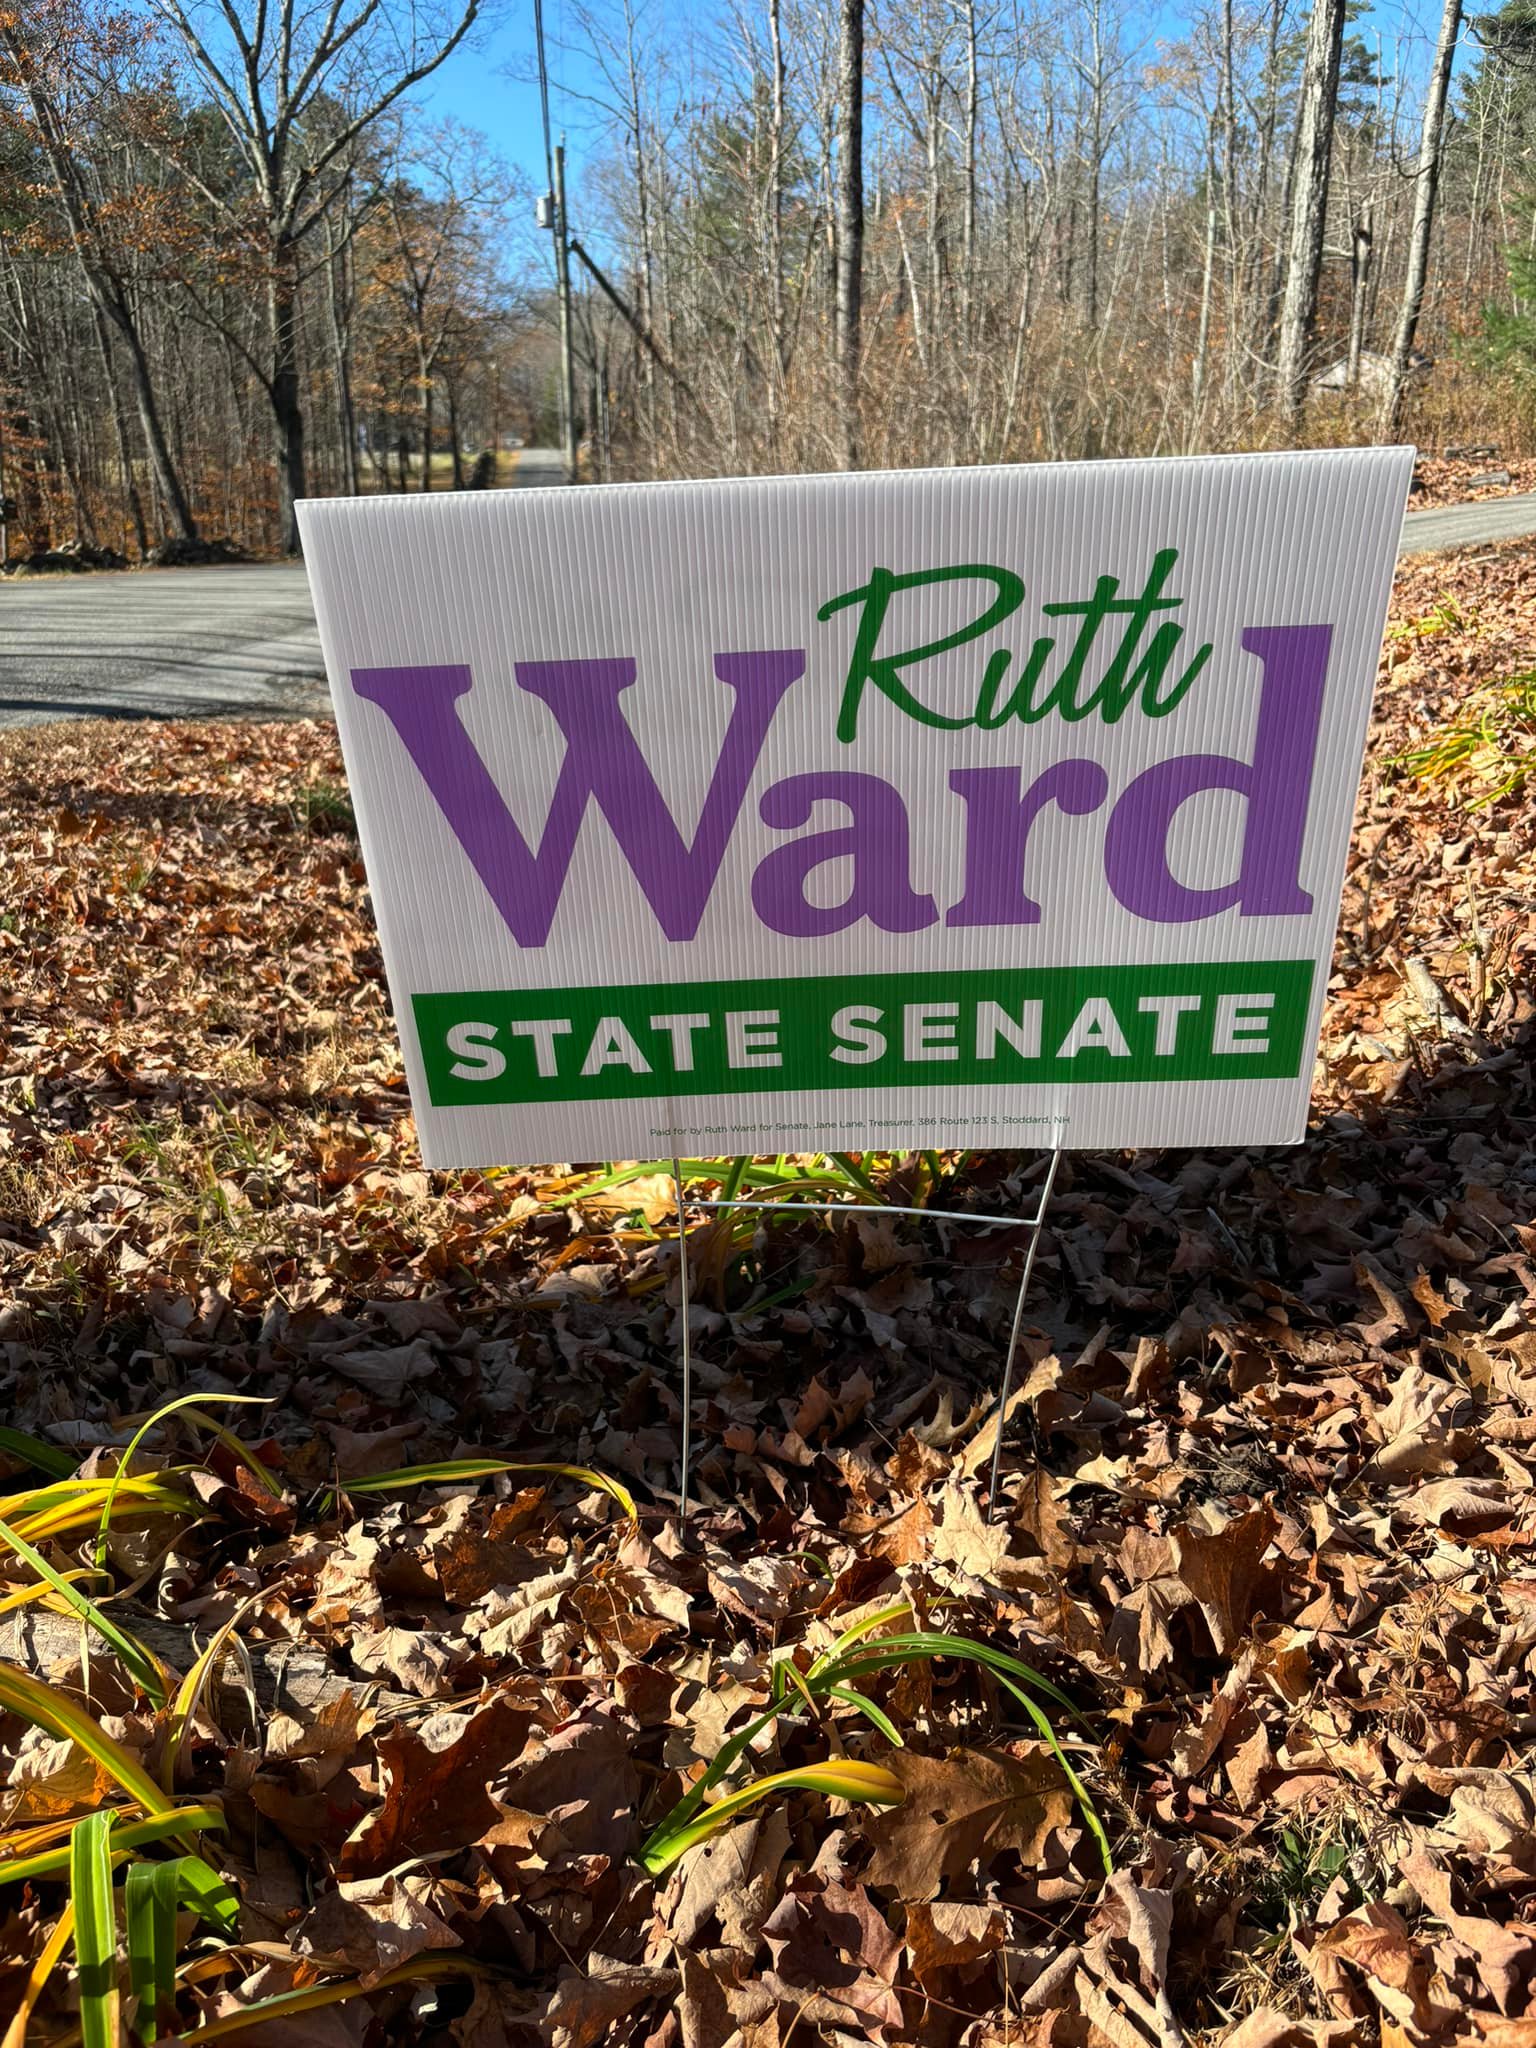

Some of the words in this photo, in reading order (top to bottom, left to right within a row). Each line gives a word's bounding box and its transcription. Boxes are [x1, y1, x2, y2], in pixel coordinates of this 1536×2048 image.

[817, 548, 1213, 744] Ruth
[351, 624, 1332, 948] Ward
[446, 1009, 783, 1082] STATE
[829, 992, 1277, 1066] SENATE
[649, 1128, 671, 1137] Paid
[673, 1127, 687, 1136] for
[690, 1127, 701, 1137] by
[705, 1125, 728, 1135] Ruth
[730, 1124, 756, 1134] Ward
[759, 1123, 773, 1132] for
[775, 1122, 811, 1132] Senate,
[813, 1121, 837, 1130] Jane
[840, 1120, 866, 1129] Lane,
[868, 1119, 915, 1128] Treasurer,
[918, 1118, 936, 1126] 386
[940, 1117, 969, 1126] Route
[972, 1116, 988, 1125] 123
[990, 1116, 1000, 1126] S,
[1002, 1115, 1051, 1125] Stoddard,
[1054, 1115, 1071, 1124] NH
